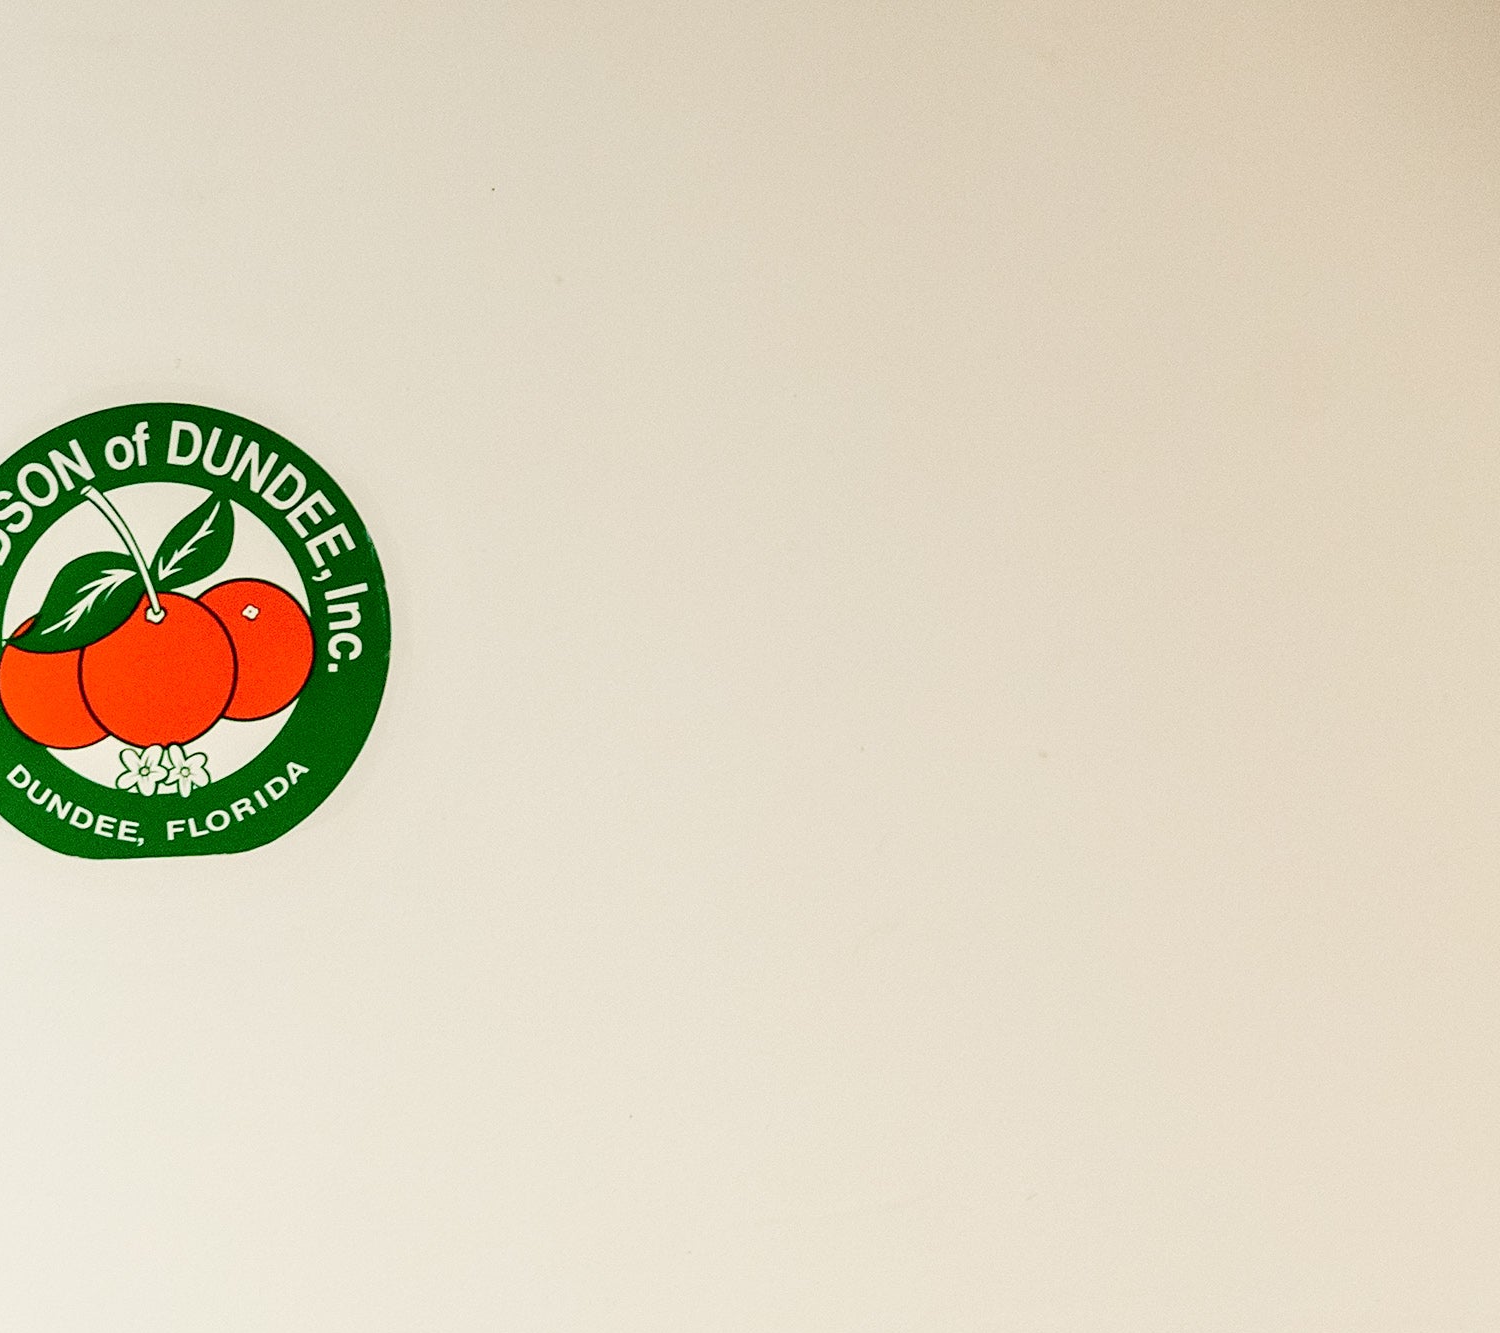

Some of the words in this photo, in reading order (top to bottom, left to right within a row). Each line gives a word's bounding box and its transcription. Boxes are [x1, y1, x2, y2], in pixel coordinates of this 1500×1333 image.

[105, 421, 150, 471] of
[167, 420, 357, 584] DUNDEE,
[325, 581, 370, 674] Inc.
[6, 763, 146, 847] DUNDEE,
[166, 761, 311, 840] FLORIDA
